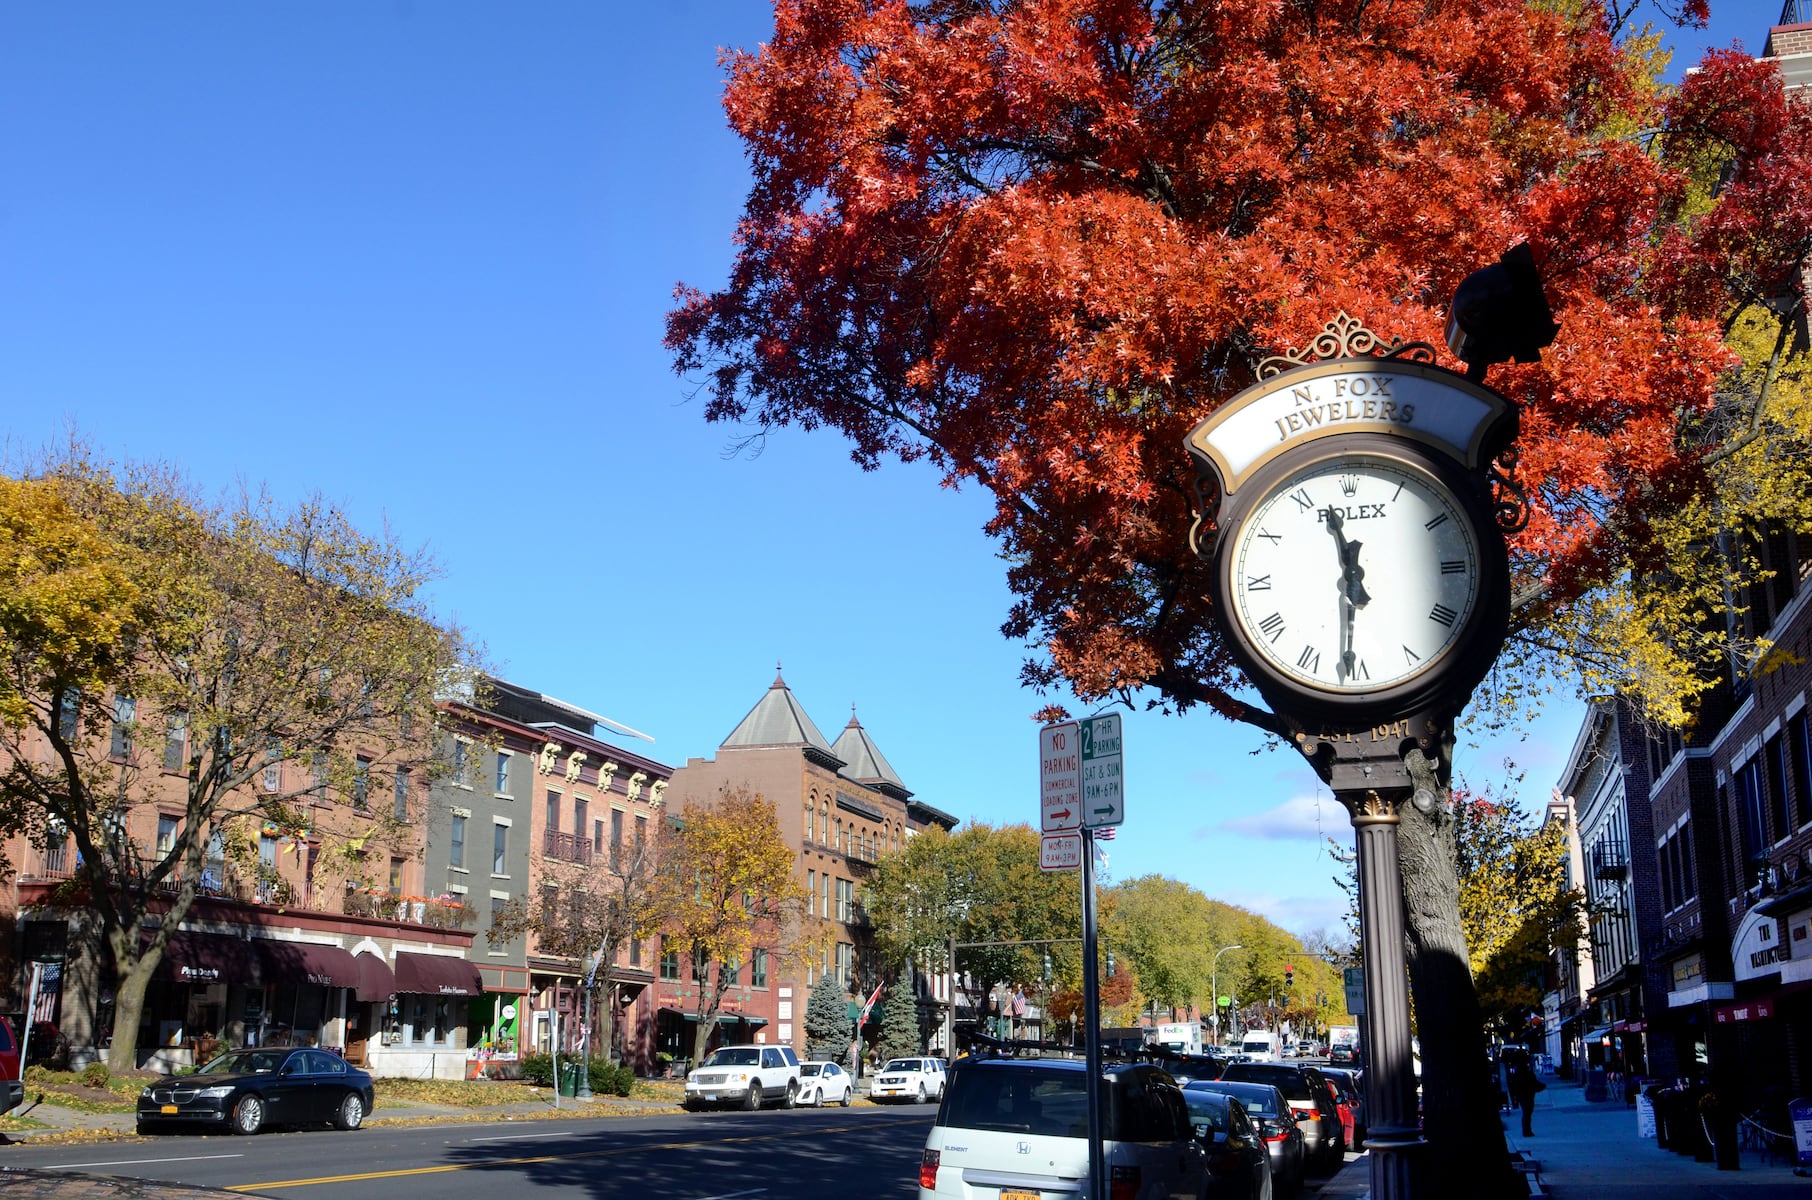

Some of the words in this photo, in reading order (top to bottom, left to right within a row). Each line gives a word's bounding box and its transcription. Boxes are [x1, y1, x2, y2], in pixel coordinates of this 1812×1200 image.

[1292, 385, 1320, 406] N.
[1334, 377, 1393, 397] FOX
[1275, 400, 1415, 441] JEWELERS
[1290, 488, 1315, 513] XI
[1317, 503, 1386, 522] ROLEX
[1425, 512, 1449, 531] II
[1257, 527, 1282, 546] X
[1441, 560, 1466, 575] III
[1402, 644, 1421, 666] V
[1083, 727, 1091, 754] 2
[1102, 720, 1112, 734] HR
[1370, 719, 1410, 742] 1947
[1052, 733, 1066, 752] NO
[1093, 737, 1120, 756] PARKING
[1044, 755, 1076, 775] PARKING
[1084, 766, 1096, 780] SAT
[1098, 765, 1105, 779] &
[1107, 762, 1120, 777] SUN
[1045, 778, 1076, 792] COMMERCIAL
[1087, 782, 1119, 799] 9AM-6PM
[1043, 795, 1063, 807] LOADING
[1065, 792, 1078, 805] ZONE
[1048, 840, 1075, 850] MON-FRI
[1758, 924, 1770, 941] THE
